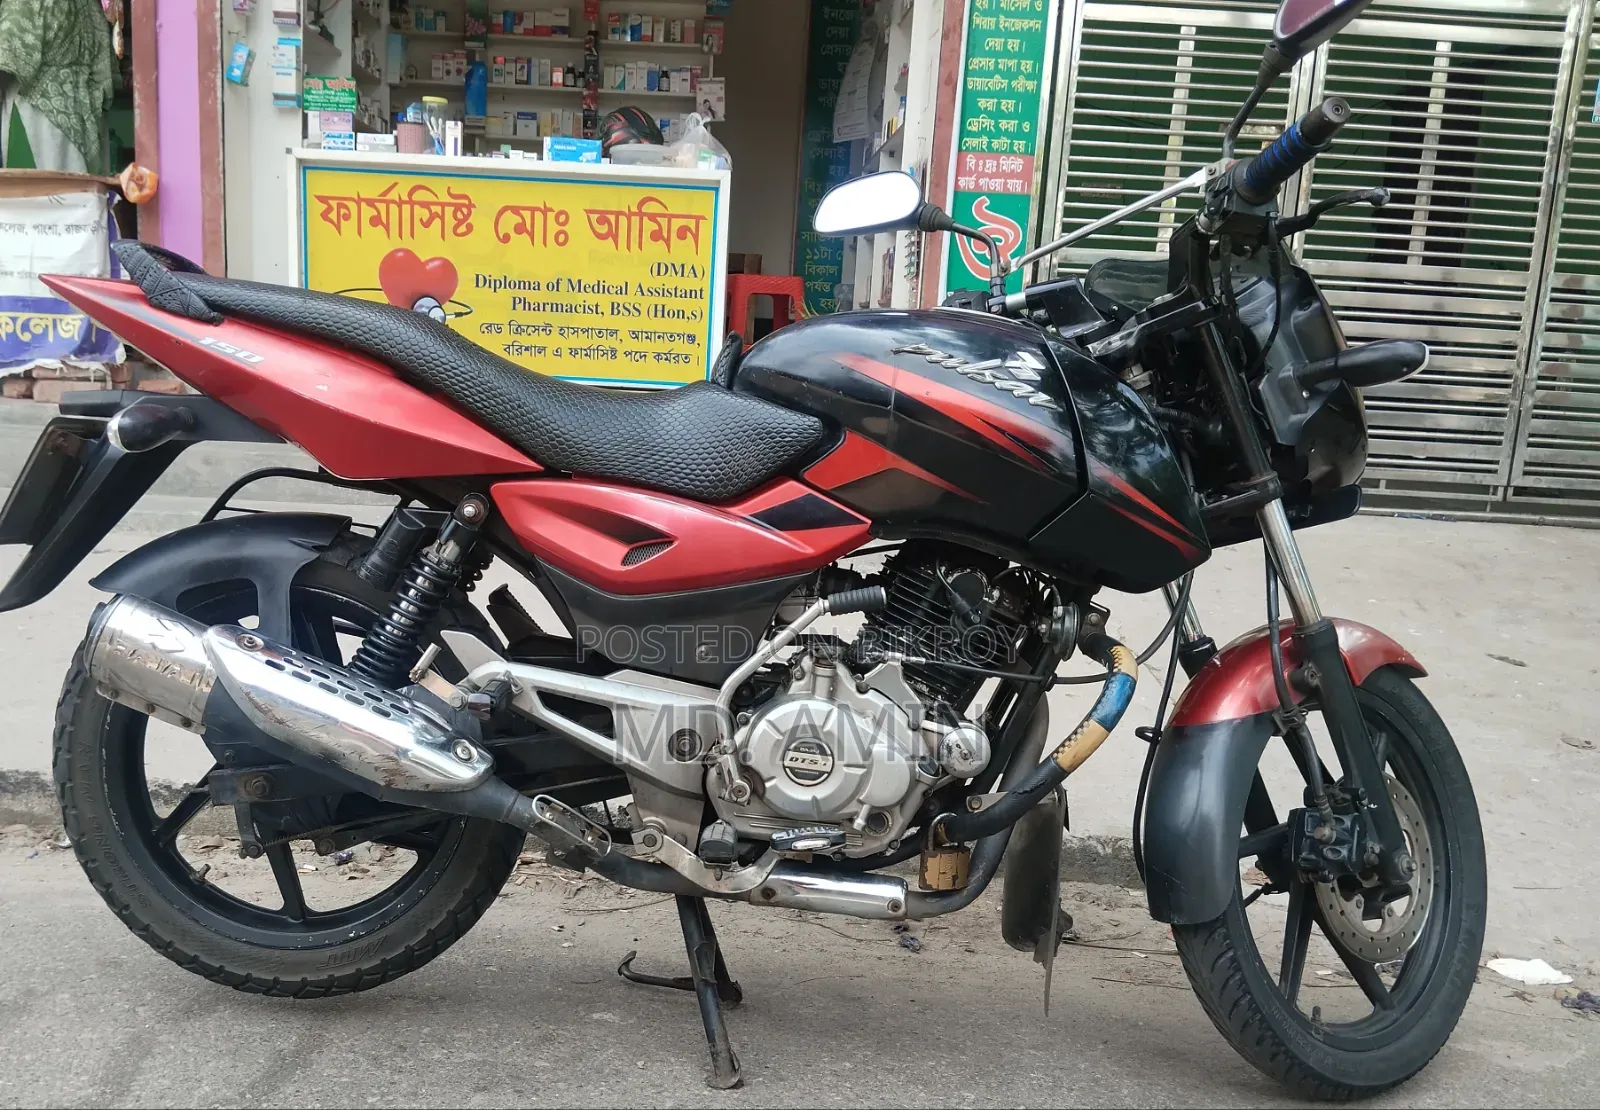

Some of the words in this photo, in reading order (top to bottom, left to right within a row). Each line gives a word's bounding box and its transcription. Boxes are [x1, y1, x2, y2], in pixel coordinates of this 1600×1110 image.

[972, 12, 996, 30] শিরায়
[999, 14, 1042, 33] ইনজেকশন
[984, 37, 1005, 52] দেয়া
[968, 56, 995, 71] প্রেসার
[998, 58, 1018, 72] মাপা
[967, 73, 1008, 92] ডায়াবেটিস
[1011, 74, 1037, 94] পরীক্ষা
[977, 98, 998, 112] করা
[966, 114, 995, 133] ড্রেসিং
[999, 119, 1018, 133] করা
[1022, 121, 1030, 133] ও
[962, 135, 989, 152] সেলাই
[991, 136, 1011, 153] কাটা
[999, 156, 1024, 174] মিনিট
[957, 173, 976, 189] কার্ড
[978, 178, 1005, 191] পাওয়া
[313, 181, 477, 242] ফার্মাসিষ্ট
[493, 200, 570, 249] মোঃ
[583, 195, 708, 257] আমিন
[649, 261, 705, 281] (DMA)
[804, 261, 839, 277] বিকাল
[474, 273, 541, 293] Diploma
[546, 277, 563, 293] of
[566, 278, 630, 297] Medical
[634, 283, 705, 300] Assistant
[511, 296, 605, 317] Pharmacist,
[609, 301, 642, 317] BSS
[646, 304, 704, 322] (Hon,s)
[479, 322, 503, 335] রেড
[508, 319, 553, 337] ক্রিসেন্ট
[557, 328, 623, 344] হাসপাতাল,
[198, 336, 265, 363] 150
[502, 340, 547, 358] বরিশাল
[552, 350, 563, 359] এ
[568, 343, 618, 361] ফার্মাসিষ্ট
[623, 350, 649, 363] পদে
